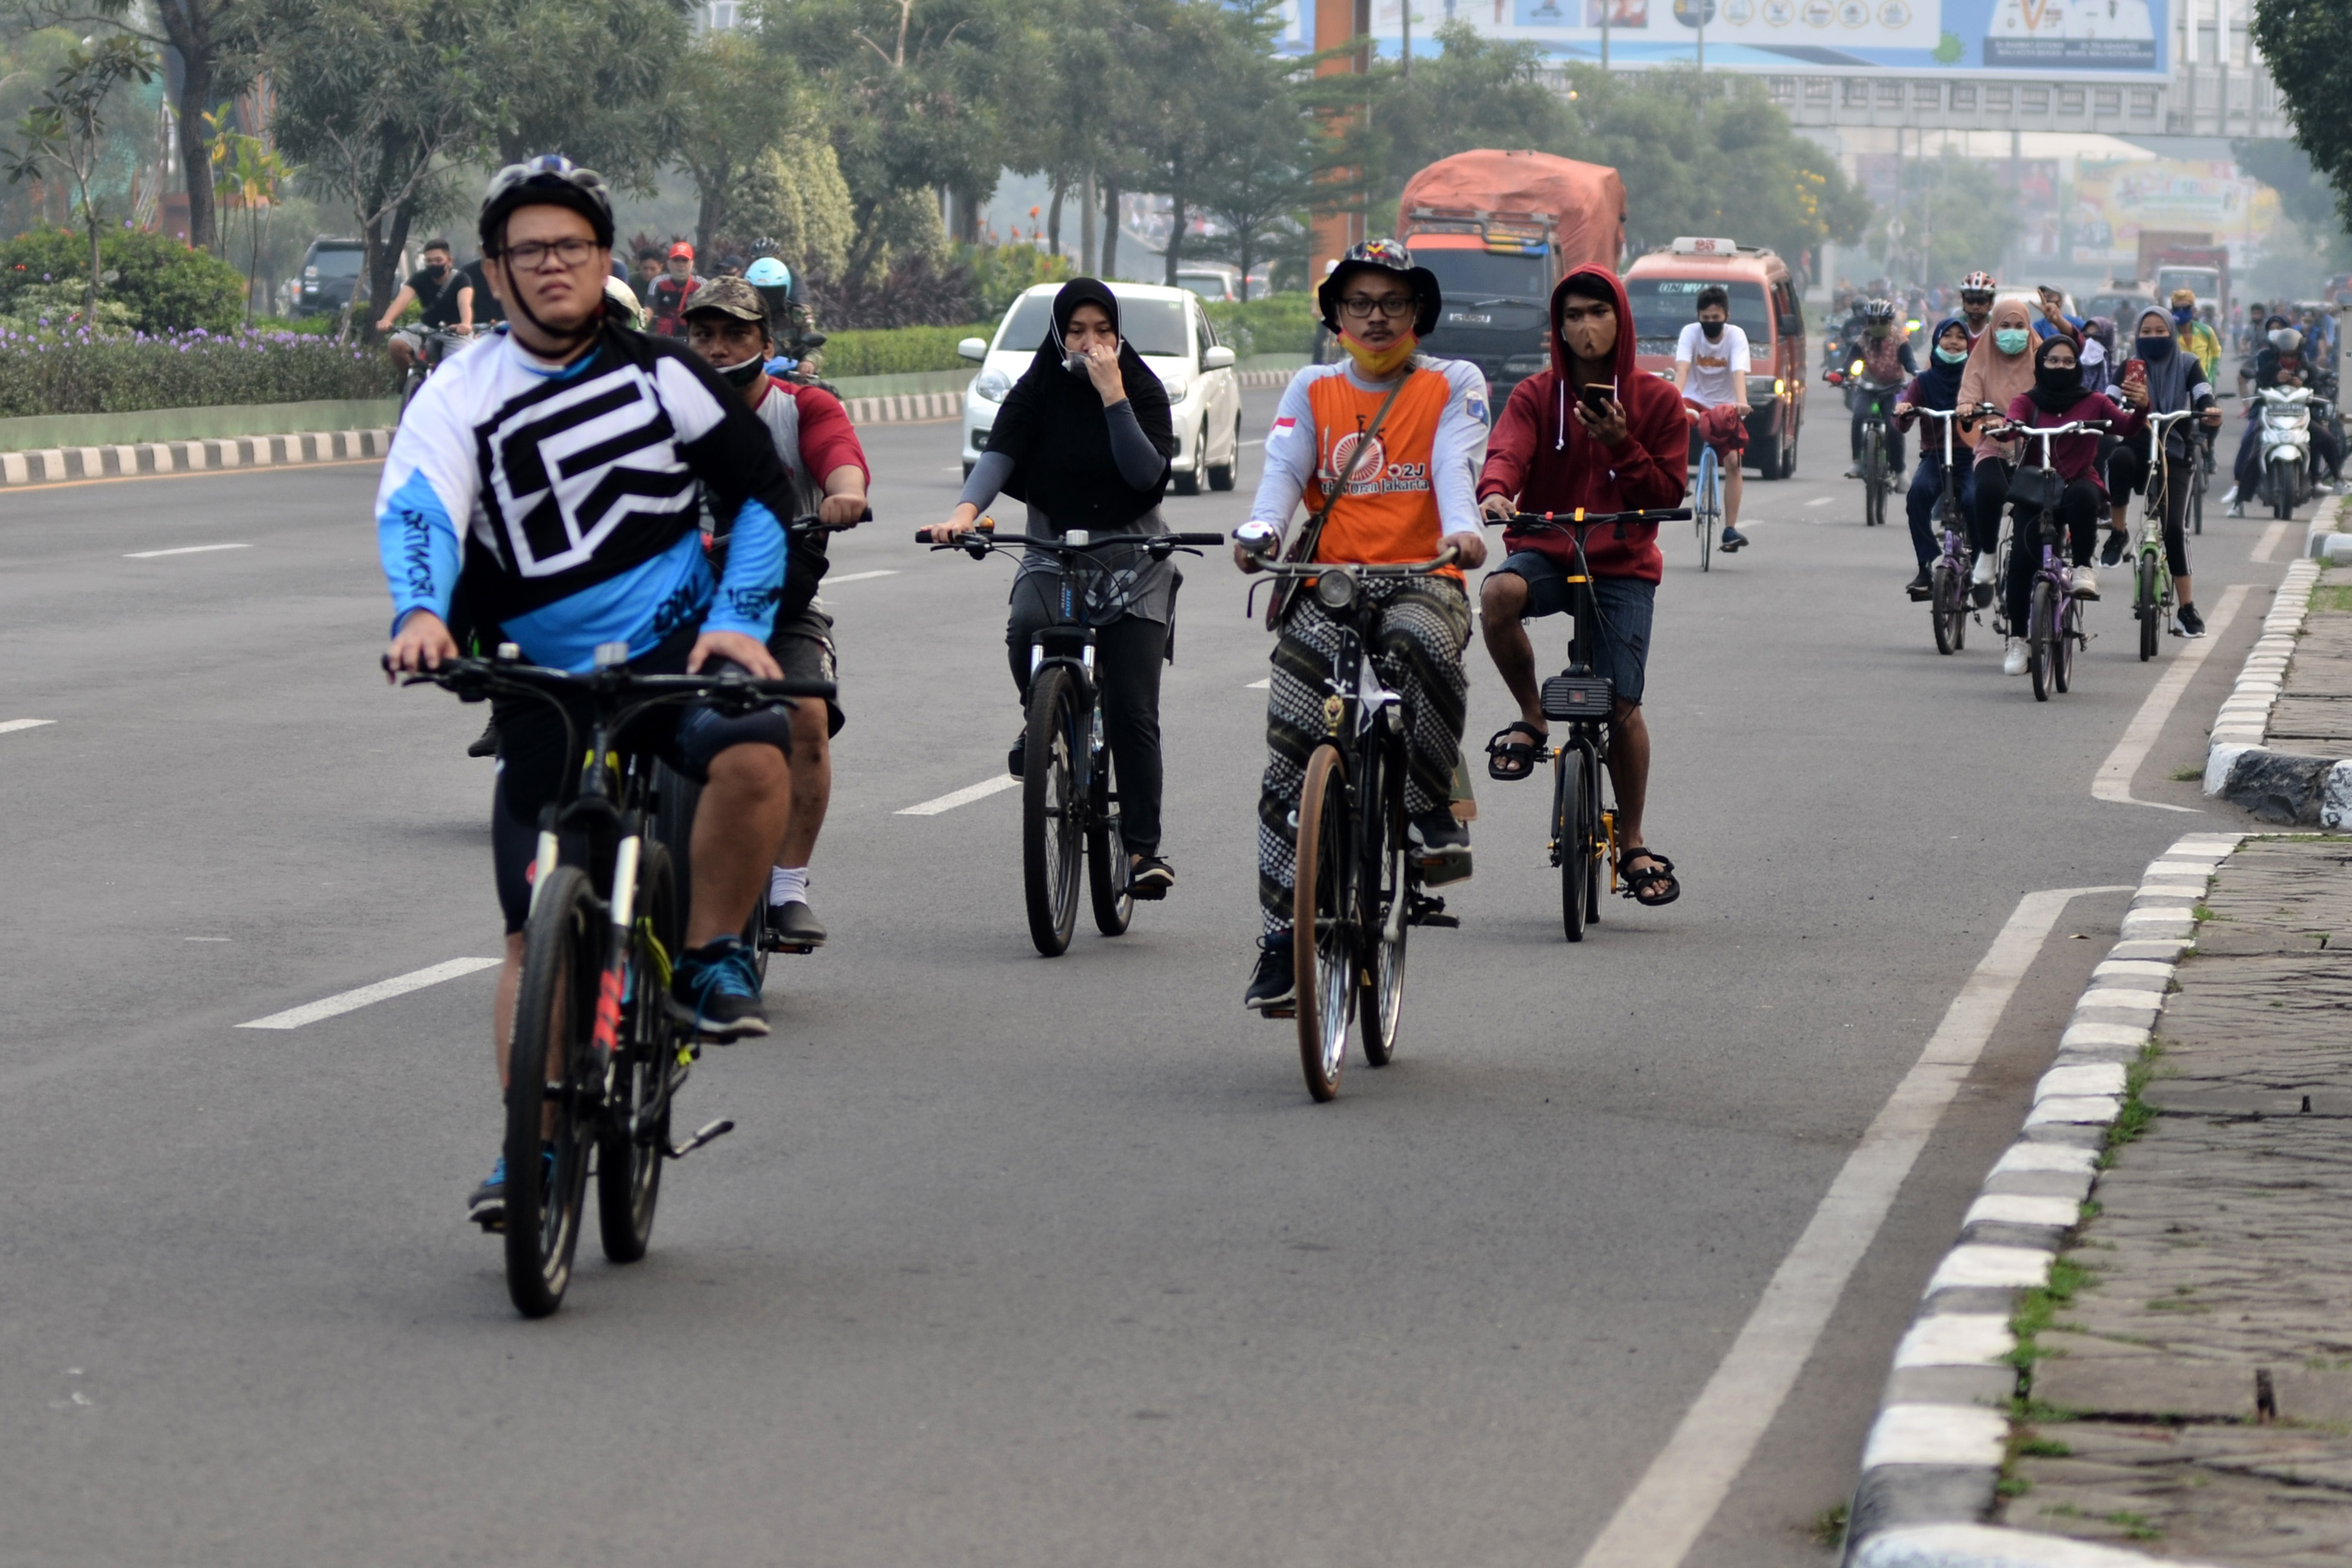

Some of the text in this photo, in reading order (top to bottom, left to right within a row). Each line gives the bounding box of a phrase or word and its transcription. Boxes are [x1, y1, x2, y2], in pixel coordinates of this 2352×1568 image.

[1694, 239, 1716, 251] 25
[1449, 313, 1491, 323] ISUZU
[1381, 477, 1429, 494] Jakarta
